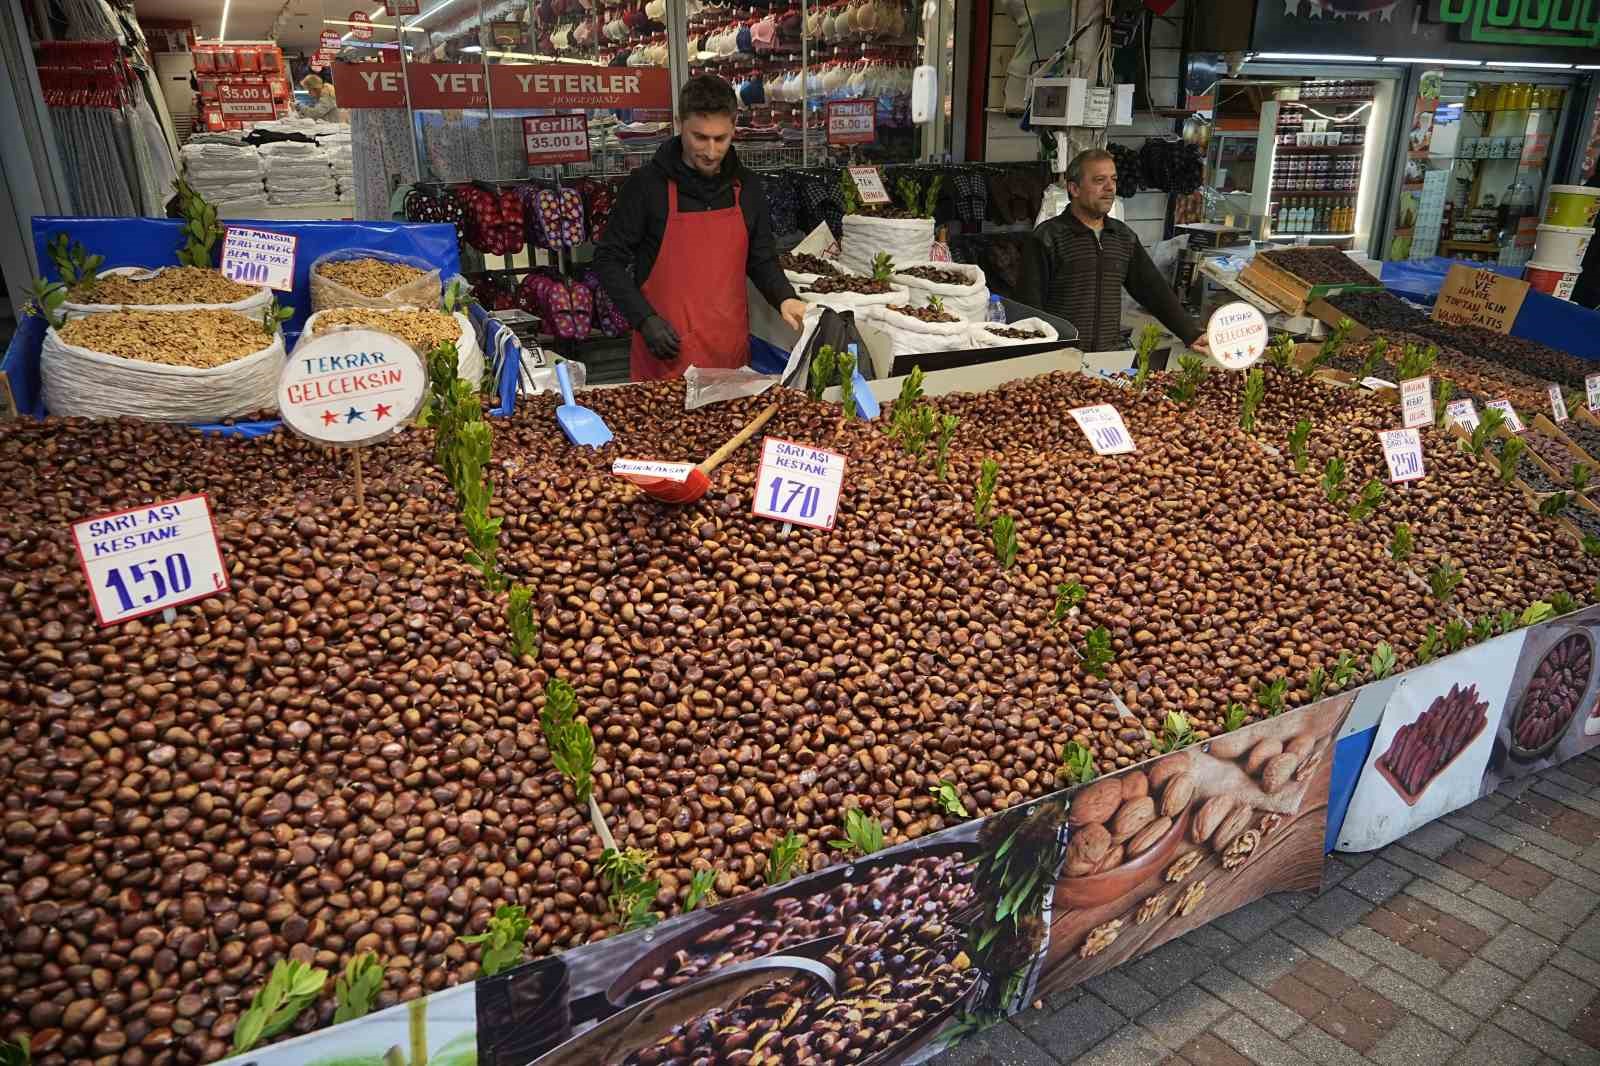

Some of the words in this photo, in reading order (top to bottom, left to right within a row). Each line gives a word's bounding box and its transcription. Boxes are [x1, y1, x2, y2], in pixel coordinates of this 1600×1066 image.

[516, 74, 641, 93] YETERLER
[525, 118, 583, 132] Terlik
[531, 136, 570, 148] 35.00
[226, 260, 269, 282] 500
[1475, 280, 1492, 292] VE
[301, 351, 385, 375] TEKRAR
[776, 443, 805, 457] SARI
[776, 456, 828, 476] KESTANE
[1392, 452, 1418, 477] 250
[768, 476, 820, 518] 170
[89, 514, 137, 537] SARI
[148, 505, 181, 524] AŞI
[94, 525, 181, 556] KESTANE
[105, 552, 192, 614] 150
